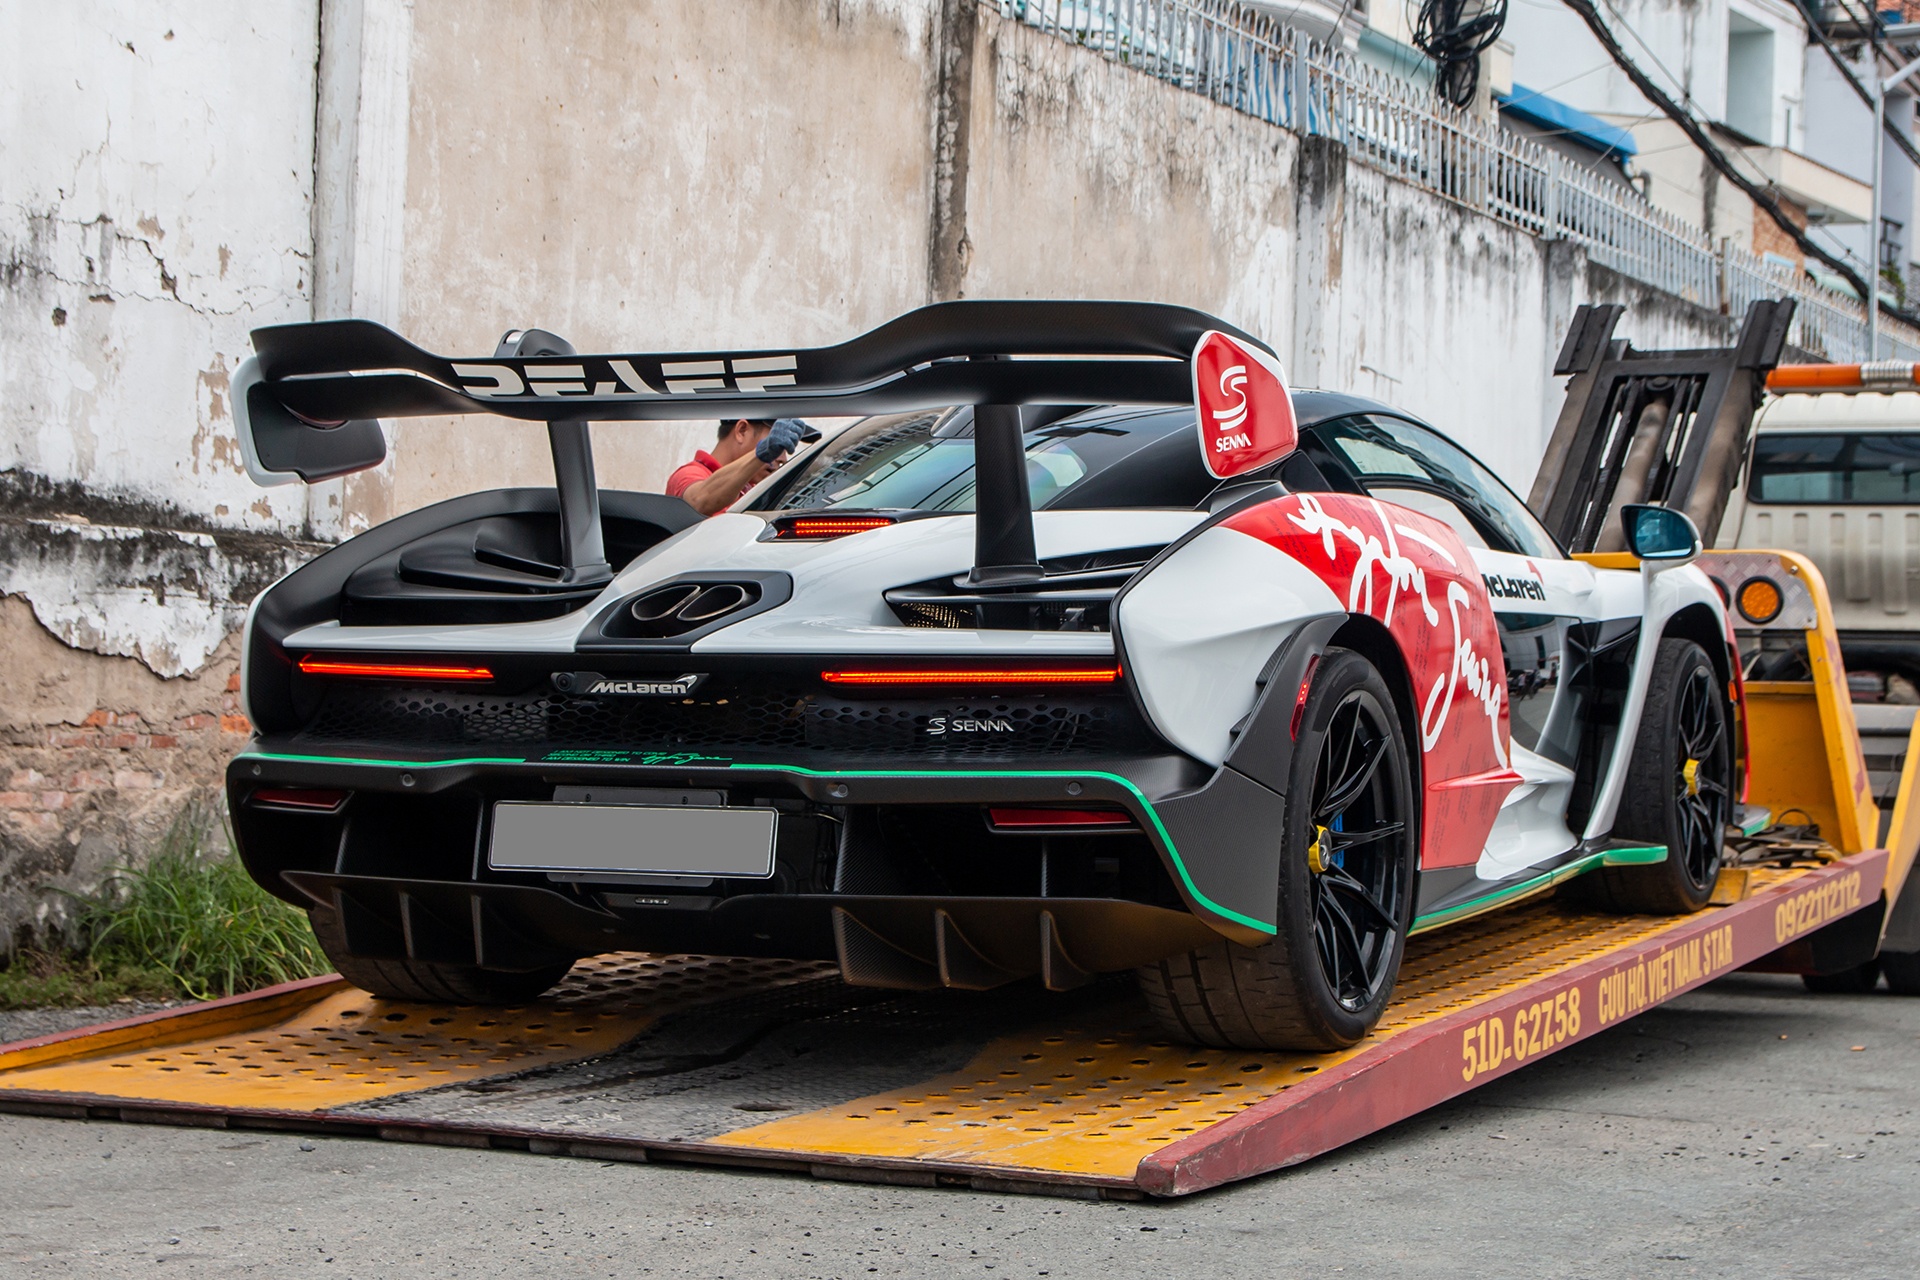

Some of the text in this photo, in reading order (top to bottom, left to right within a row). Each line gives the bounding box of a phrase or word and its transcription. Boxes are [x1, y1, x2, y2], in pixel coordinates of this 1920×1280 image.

[1216, 433, 1252, 453] SENNA
[590, 682, 687, 694] McLaren
[952, 719, 1015, 732] SENNA
[1775, 870, 1861, 944] 0922112112
[1703, 924, 1733, 976] STAR
